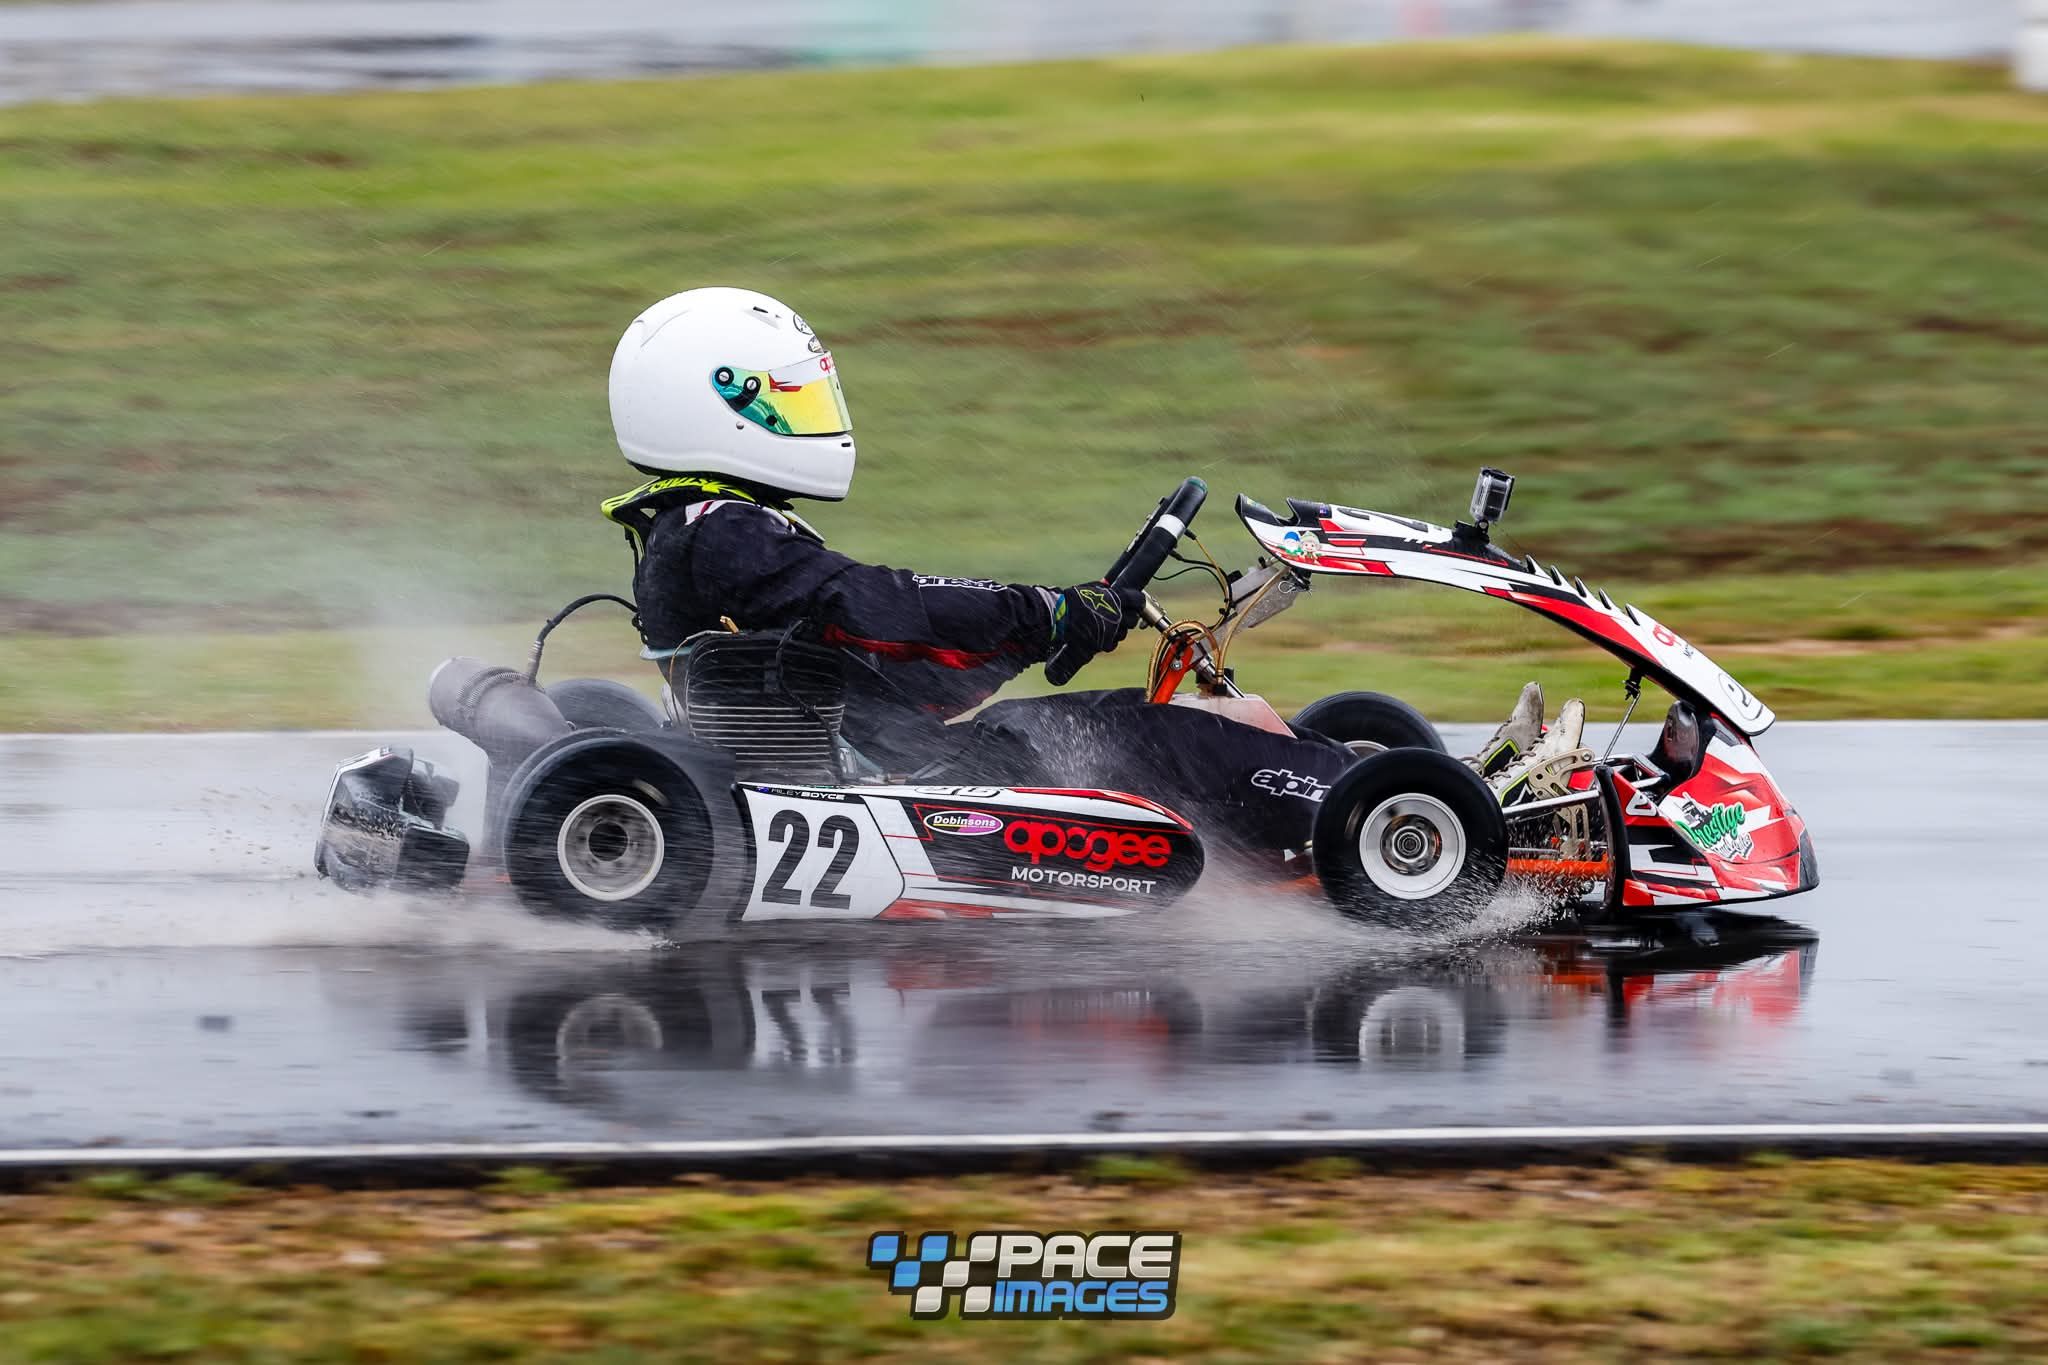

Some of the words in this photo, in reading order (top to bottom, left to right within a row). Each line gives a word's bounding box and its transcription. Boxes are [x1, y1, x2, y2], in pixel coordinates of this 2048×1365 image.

[933, 815, 996, 827] Dobinsons
[761, 809, 860, 910] 22
[1003, 820, 1172, 873] apogee
[1011, 866, 1156, 894] MOTORSPORT
